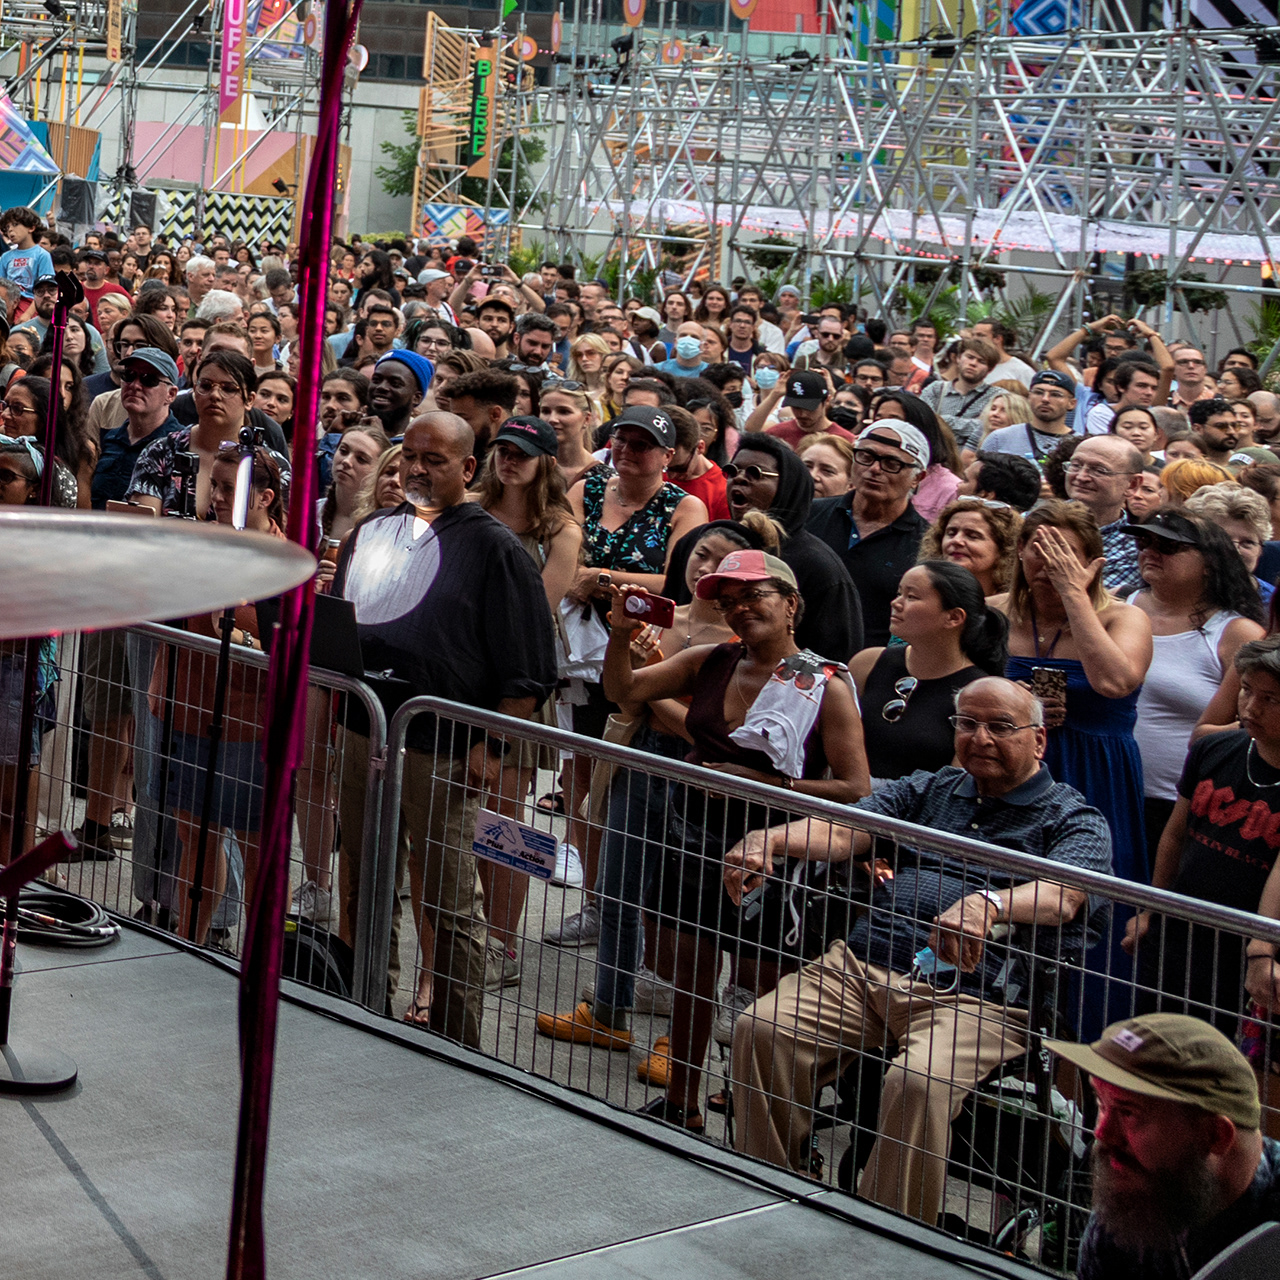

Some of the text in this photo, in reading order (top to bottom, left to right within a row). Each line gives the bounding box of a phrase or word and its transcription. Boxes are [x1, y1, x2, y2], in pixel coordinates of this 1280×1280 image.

[472, 60, 491, 156] BIÈRE
[486, 838, 504, 851] Plus
[518, 851, 545, 866] Action
